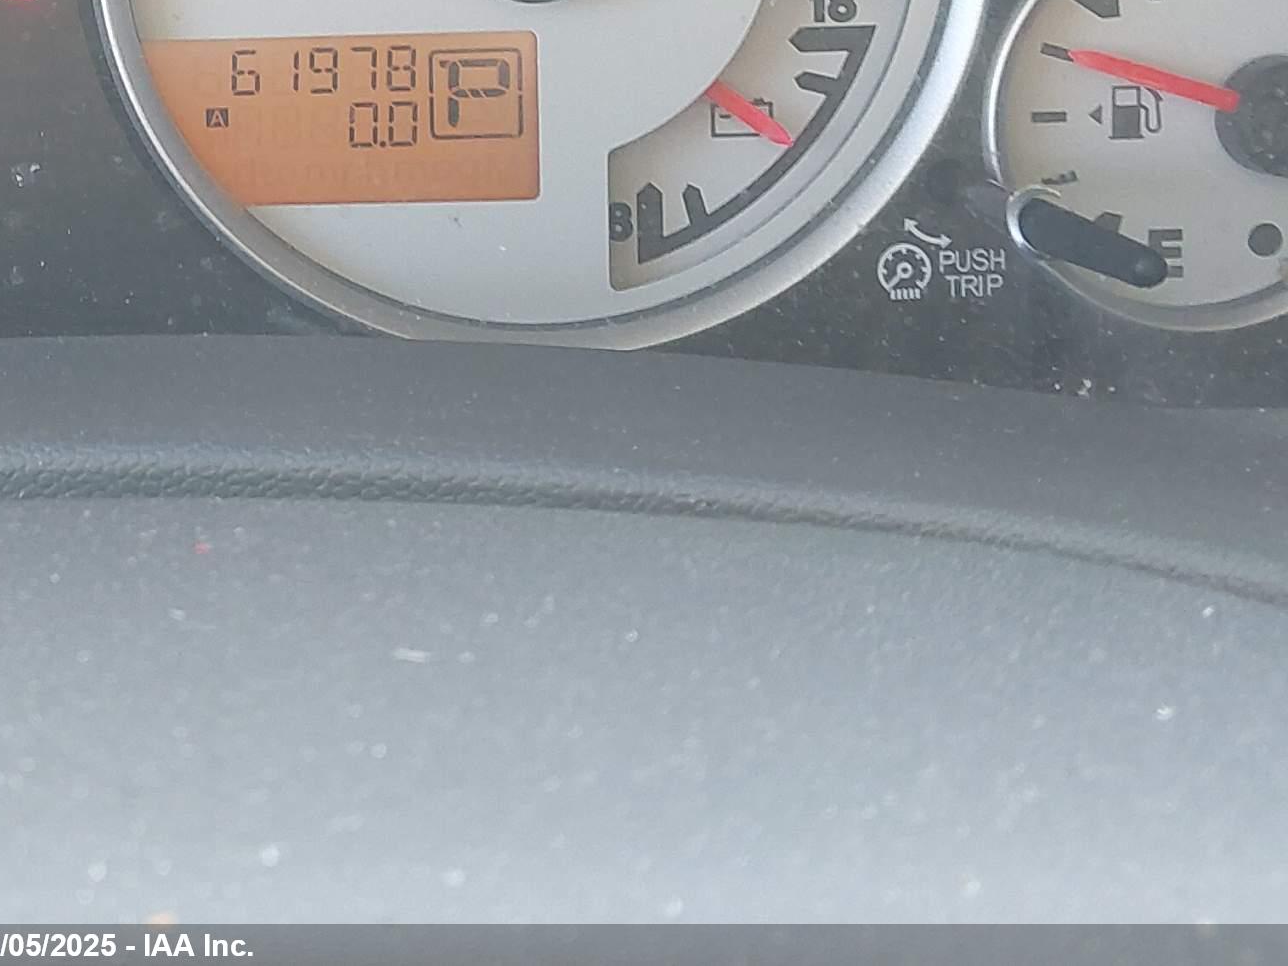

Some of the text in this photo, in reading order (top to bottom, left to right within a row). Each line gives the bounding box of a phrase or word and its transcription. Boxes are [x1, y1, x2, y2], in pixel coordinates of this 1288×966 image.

[231, 46, 416, 96] 61978
[448, 59, 510, 128] P
[349, 102, 417, 148] 0.0
[939, 250, 1006, 271] PUSH
[945, 276, 1003, 296] TRIP
